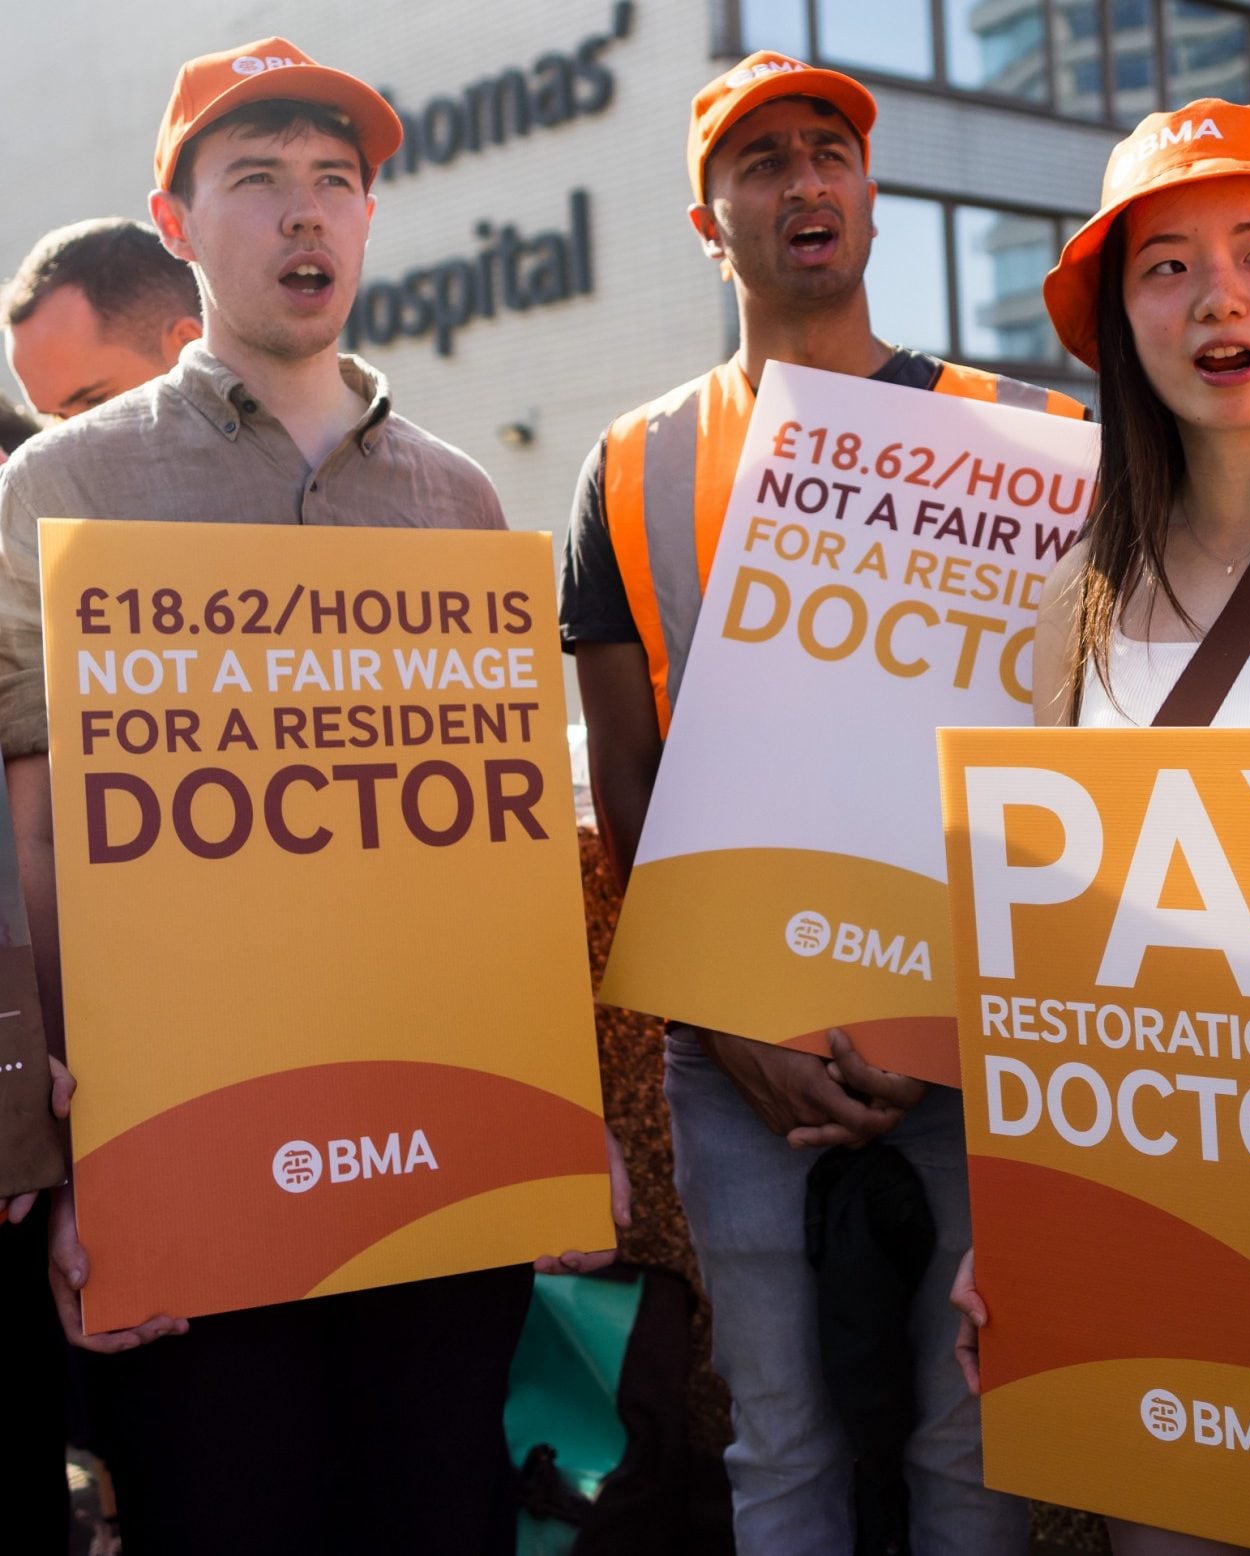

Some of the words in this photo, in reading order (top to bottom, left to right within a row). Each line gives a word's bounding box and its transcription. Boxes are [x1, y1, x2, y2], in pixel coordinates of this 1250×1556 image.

[378, 0, 635, 183] homas'
[1138, 118, 1224, 162] BMA
[343, 187, 596, 360] ospital
[756, 468, 861, 520] NOT
[865, 492, 900, 534] A
[912, 500, 1021, 556] FAIR
[771, 420, 1099, 520] £18.62/HOU
[743, 516, 846, 571] FOR
[853, 538, 888, 579] A
[904, 548, 1046, 611] RESID
[75, 583, 471, 636] £18.62/HOUR
[487, 590, 532, 634] IS
[721, 566, 1036, 706] DOCTO
[78, 650, 197, 695] NOT
[212, 649, 252, 693] A
[266, 649, 382, 693] FAIR
[394, 647, 538, 690] WAGE
[80, 709, 200, 755] FOR
[217, 708, 257, 752] A
[273, 702, 539, 750] RESIDENT
[85, 759, 549, 864] DOCTOR
[831, 923, 932, 981] BMA
[328, 1129, 439, 1184] BMA
